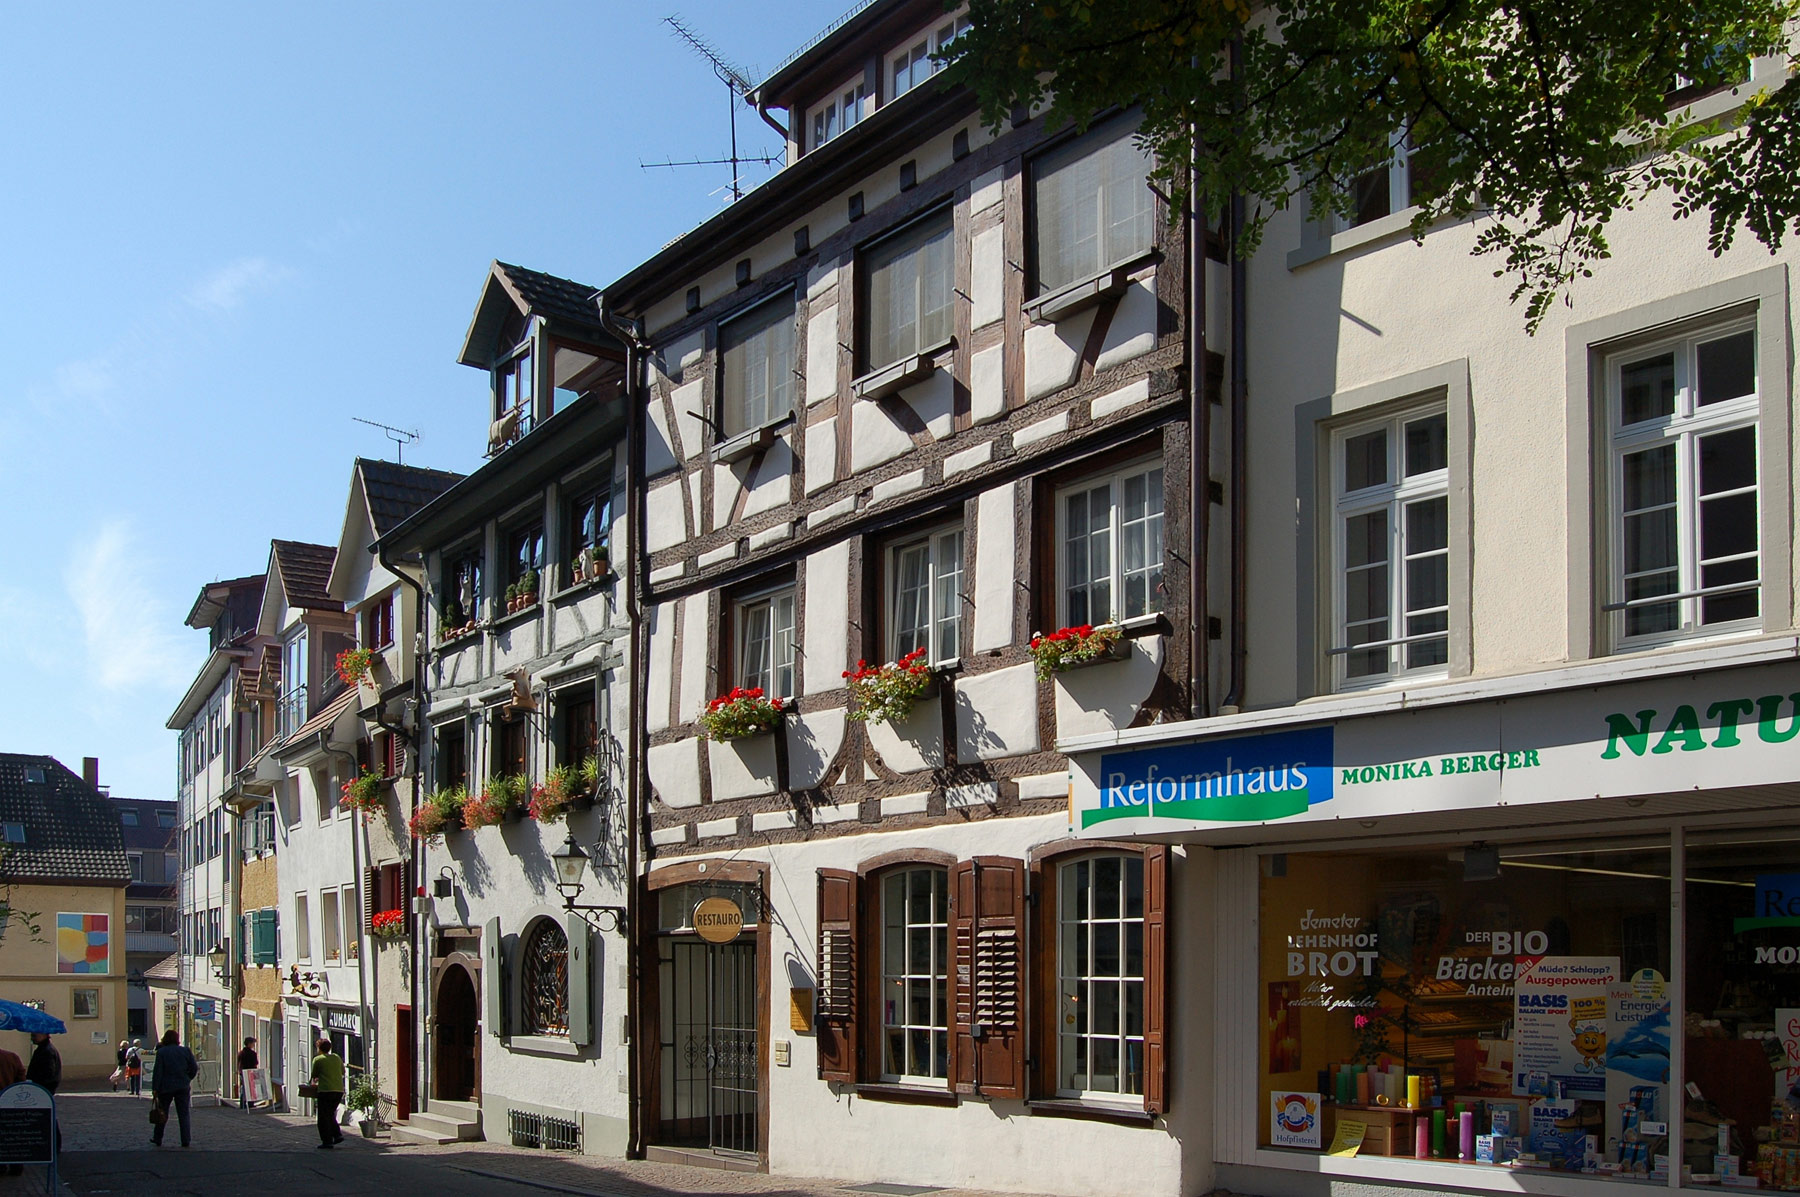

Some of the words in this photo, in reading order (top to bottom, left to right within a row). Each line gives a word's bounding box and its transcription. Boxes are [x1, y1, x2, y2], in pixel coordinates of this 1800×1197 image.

[1600, 693, 1800, 760] NATU
[1341, 761, 1433, 786] MONIKA
[1440, 749, 1540, 776] BERGER
[1107, 757, 1309, 818] Reformhaus
[697, 912, 741, 927] RESTAURO
[1300, 909, 1361, 931] demeter
[1287, 933, 1378, 949] LEHENHOF
[1465, 931, 1491, 943] DER
[1491, 930, 1549, 955] BIO
[1287, 951, 1379, 977] BROT
[1538, 965, 1568, 974] Müde?
[1570, 965, 1611, 975] Schlapp?
[1525, 974, 1614, 987] Ausgepowert?
[1518, 994, 1568, 1008] BASIS
[1611, 991, 1633, 999] Mehr
[1573, 1000, 1593, 1008] 100
[1620, 1000, 1661, 1013] Energie
[1533, 1107, 1569, 1118] BASIS
[1276, 1134, 1317, 1145] Hofpfisterei
